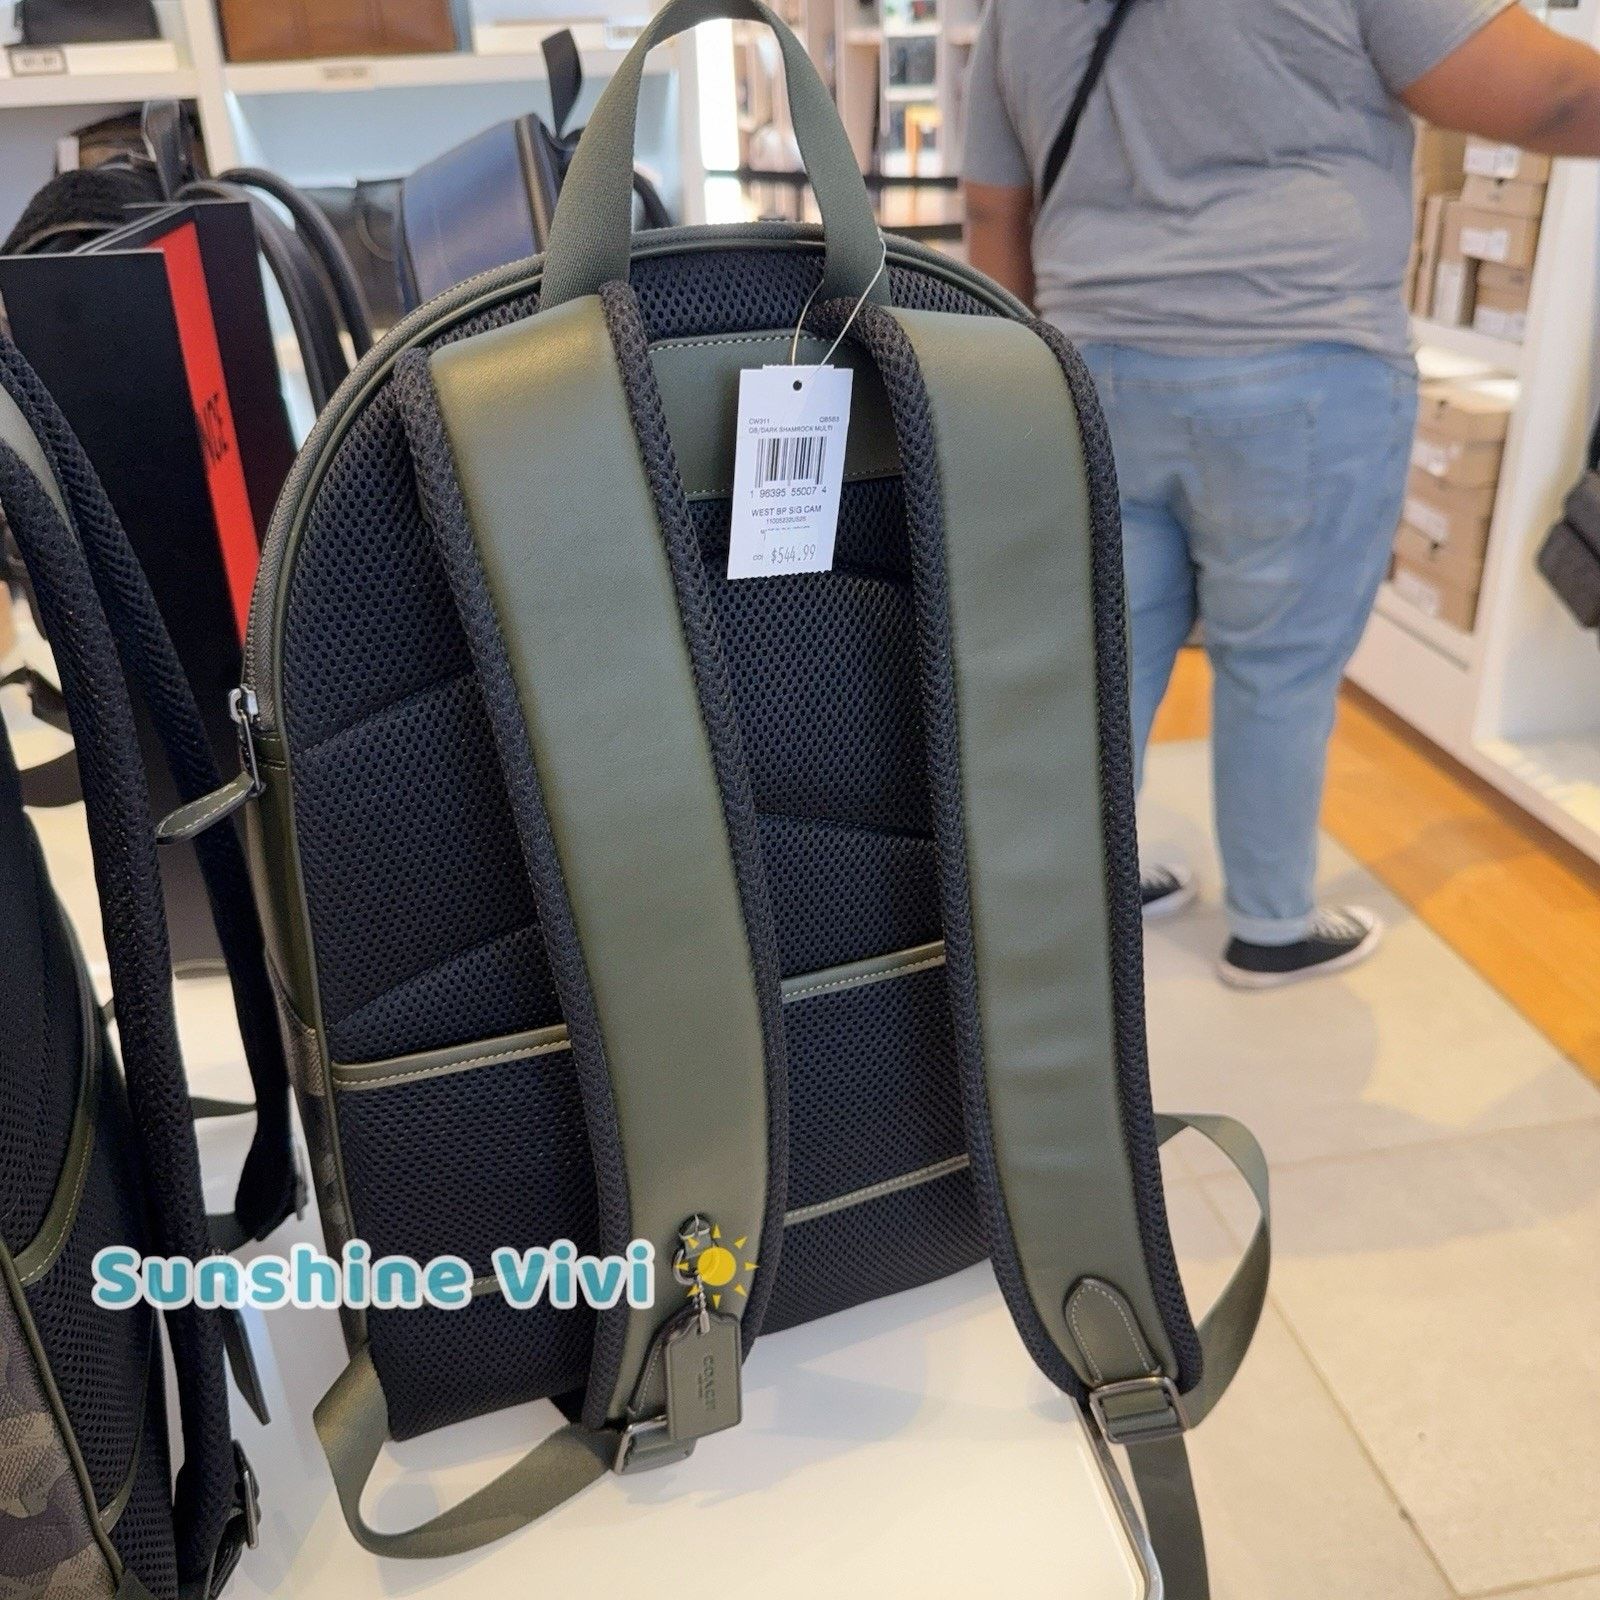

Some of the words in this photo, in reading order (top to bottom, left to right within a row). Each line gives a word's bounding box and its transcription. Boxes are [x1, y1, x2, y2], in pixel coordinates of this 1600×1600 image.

[750, 490, 754, 498] 1
[759, 488, 786, 498] 96395
[791, 486, 817, 497] 55007
[751, 508, 774, 517] WEST
[776, 507, 787, 516] BP
[789, 506, 802, 515] SIG
[804, 505, 822, 513] CAM
[771, 544, 816, 564] $544.99
